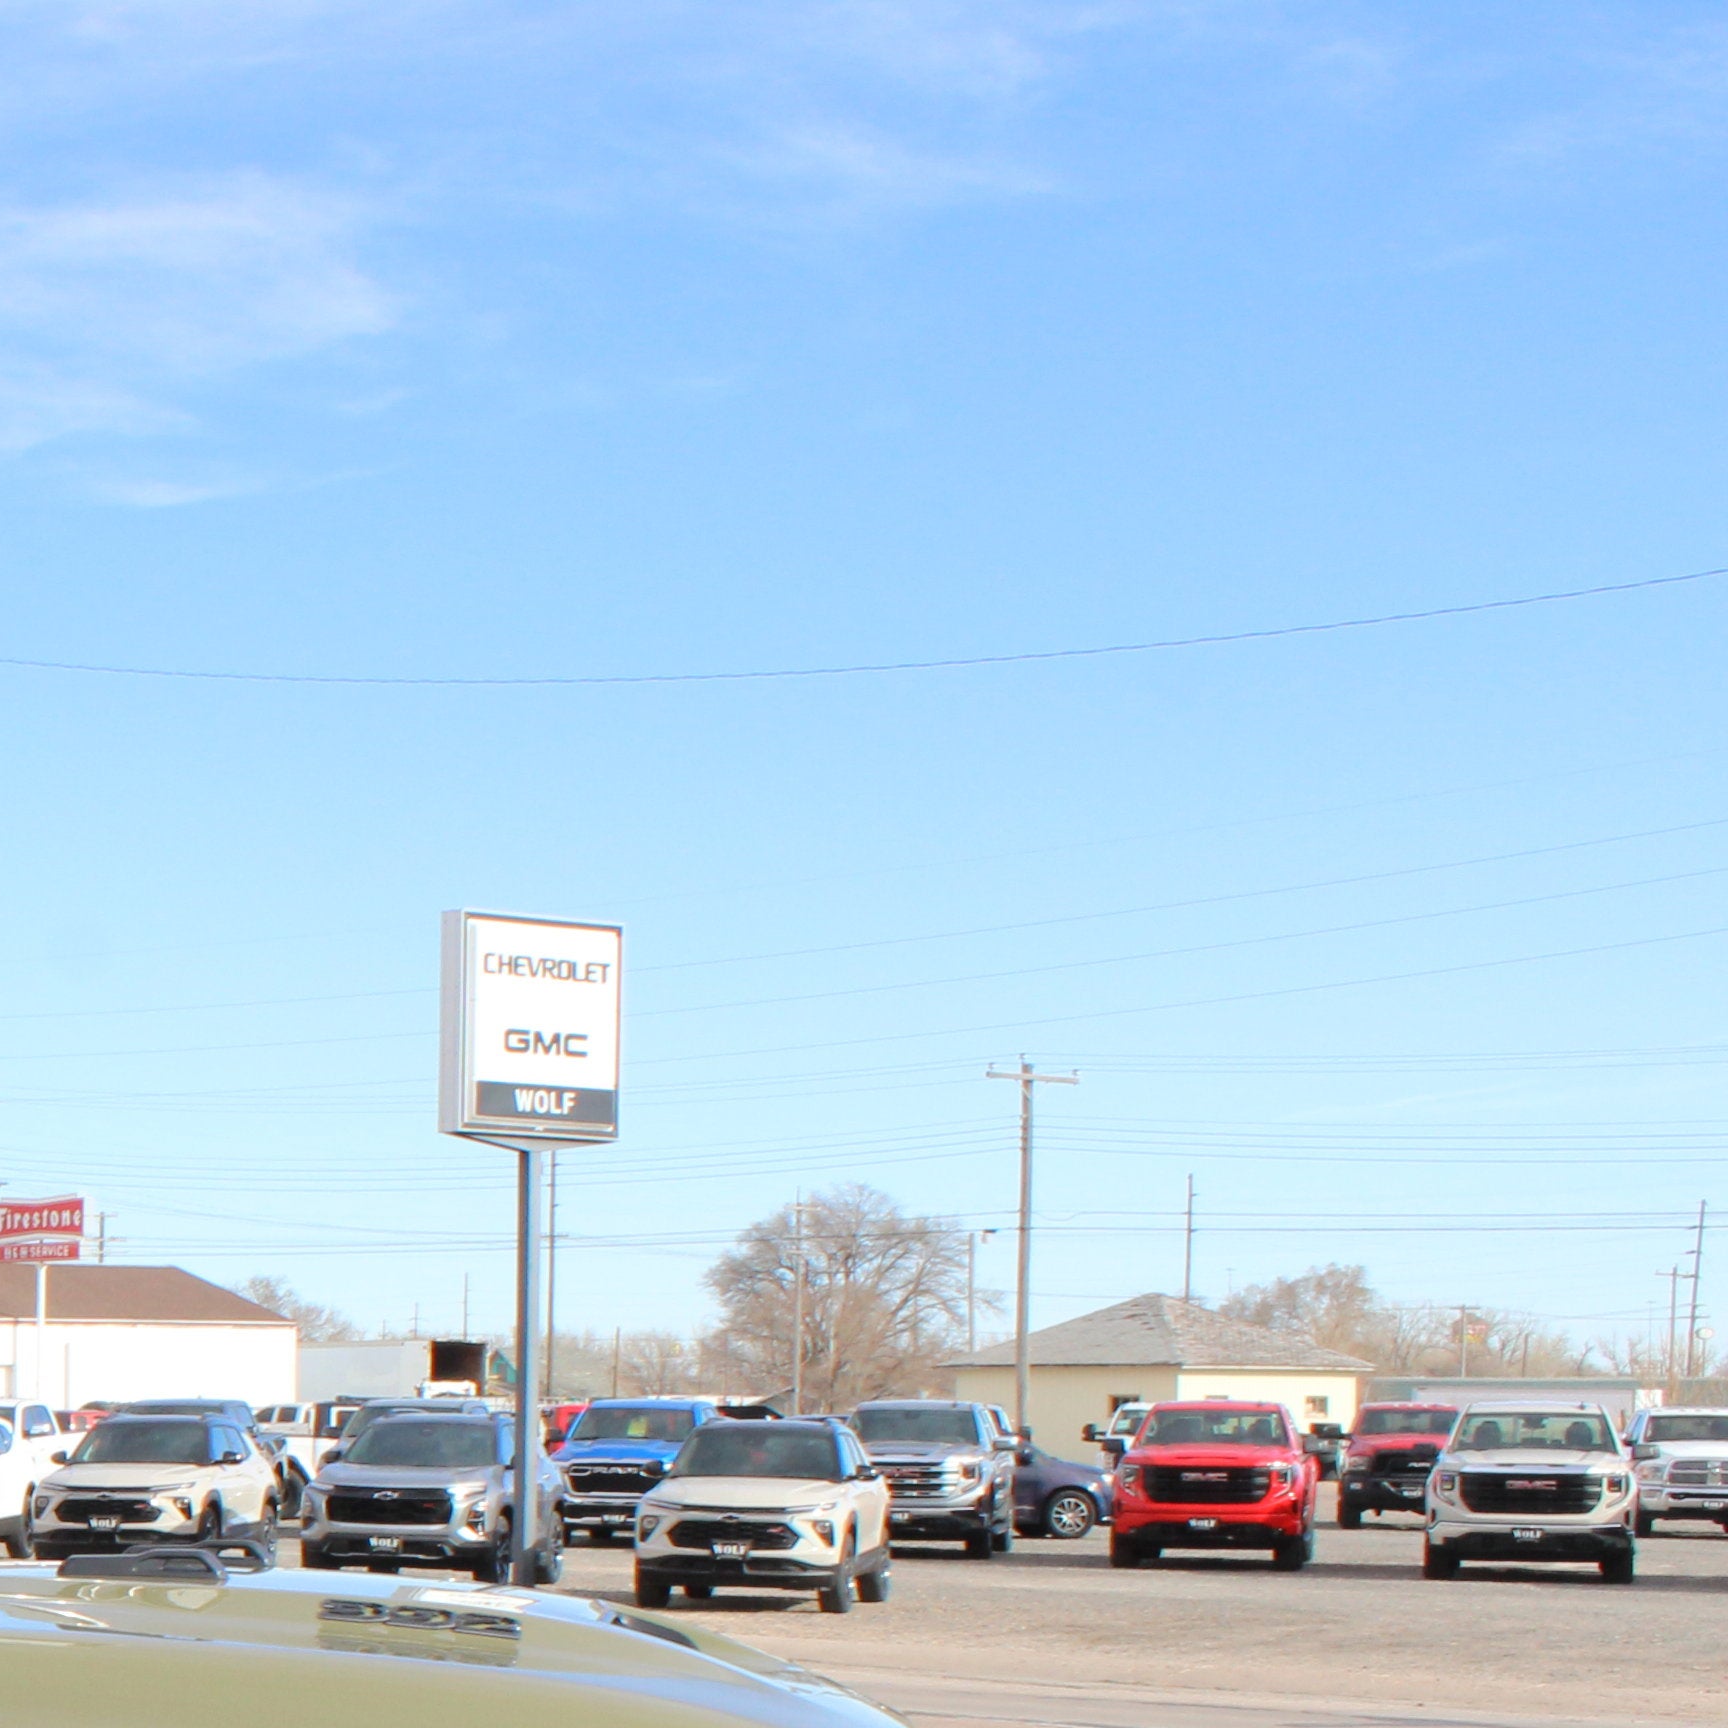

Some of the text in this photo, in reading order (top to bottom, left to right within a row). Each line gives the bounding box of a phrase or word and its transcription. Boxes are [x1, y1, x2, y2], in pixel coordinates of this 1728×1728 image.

[483, 953, 610, 983] CHEVROLET
[504, 1028, 588, 1058] GMC
[514, 1088, 577, 1115] WOLF
[30, 1244, 70, 1257] SERVICE
[318, 1600, 522, 1640] 392
